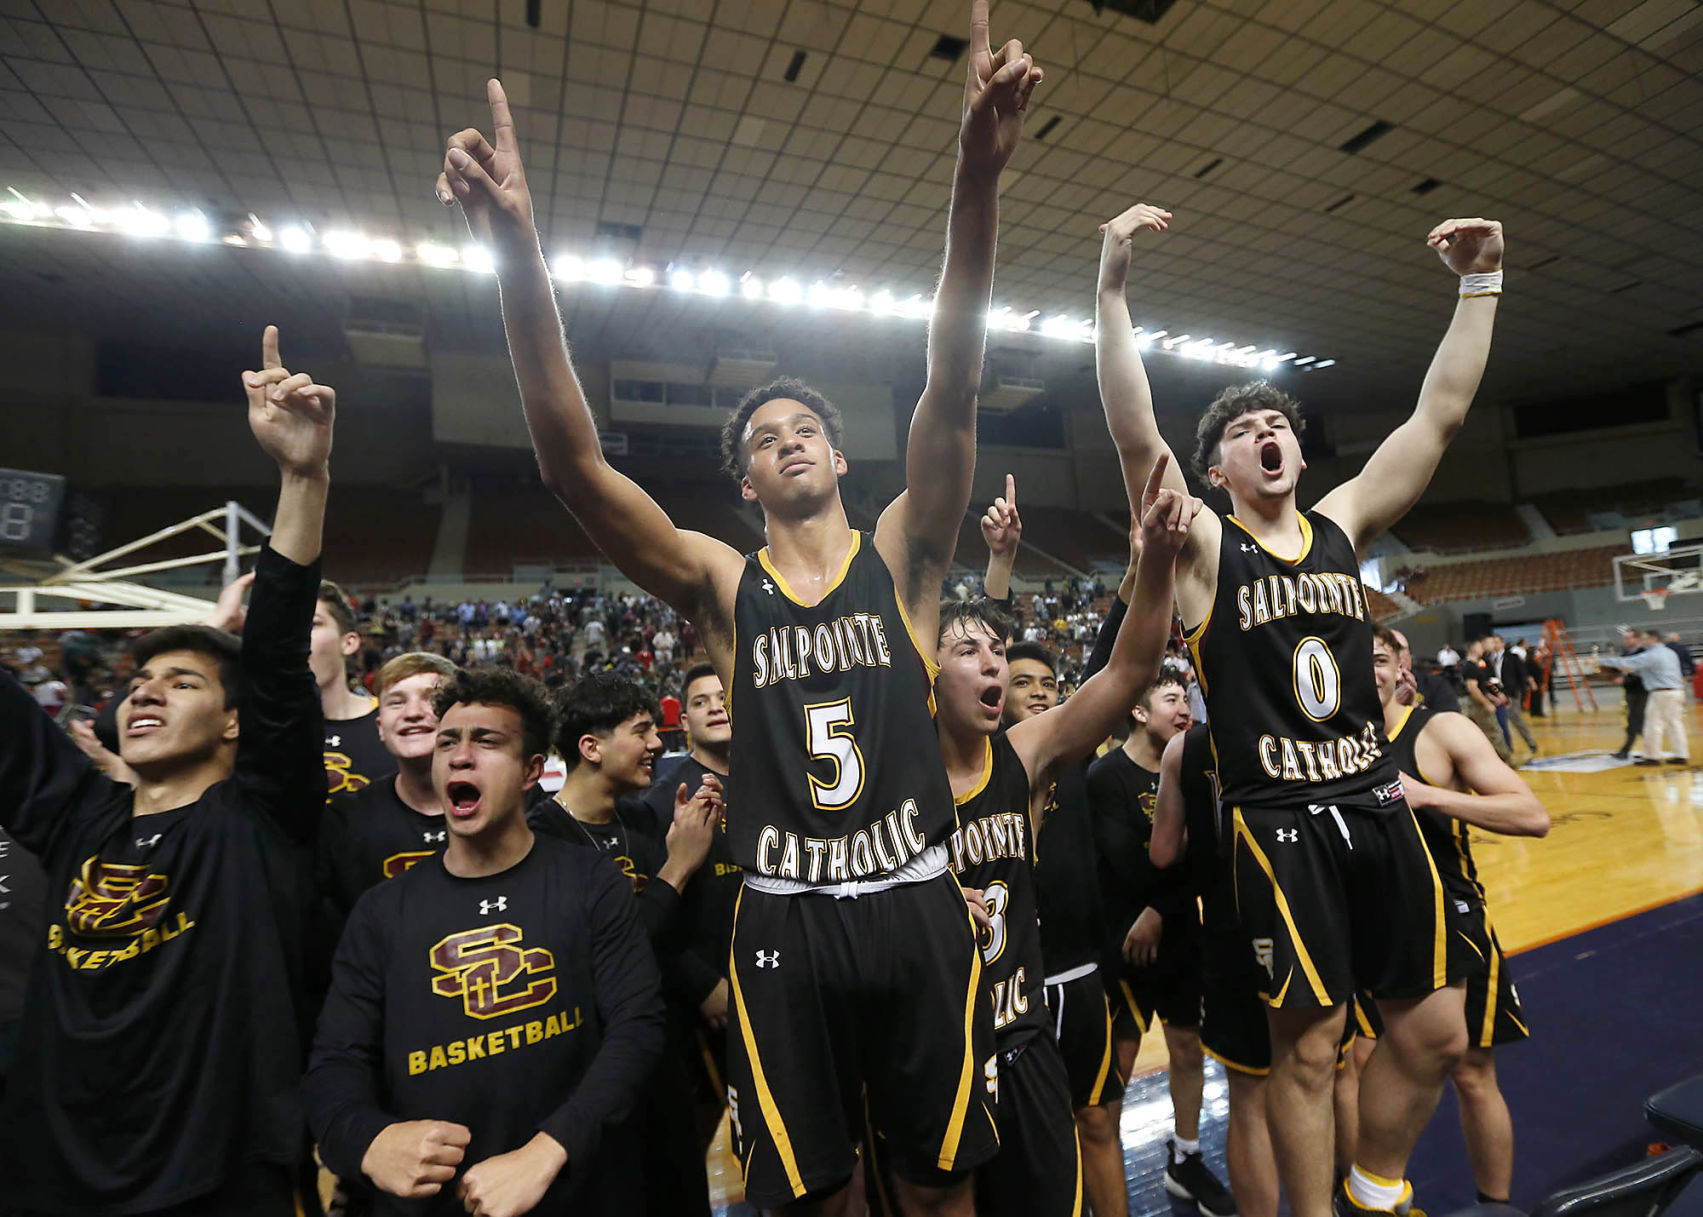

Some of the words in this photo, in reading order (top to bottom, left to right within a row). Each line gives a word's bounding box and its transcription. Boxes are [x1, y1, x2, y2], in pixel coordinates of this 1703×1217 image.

[1238, 572, 1364, 631] SALPOINTE
[753, 612, 892, 689] SALPOINTE
[1292, 635, 1341, 723] 0
[804, 696, 866, 811] 5
[756, 798, 926, 884] CATHOLIC
[948, 812, 1026, 875] POINTE
[408, 1006, 584, 1076] BASKETBALL
